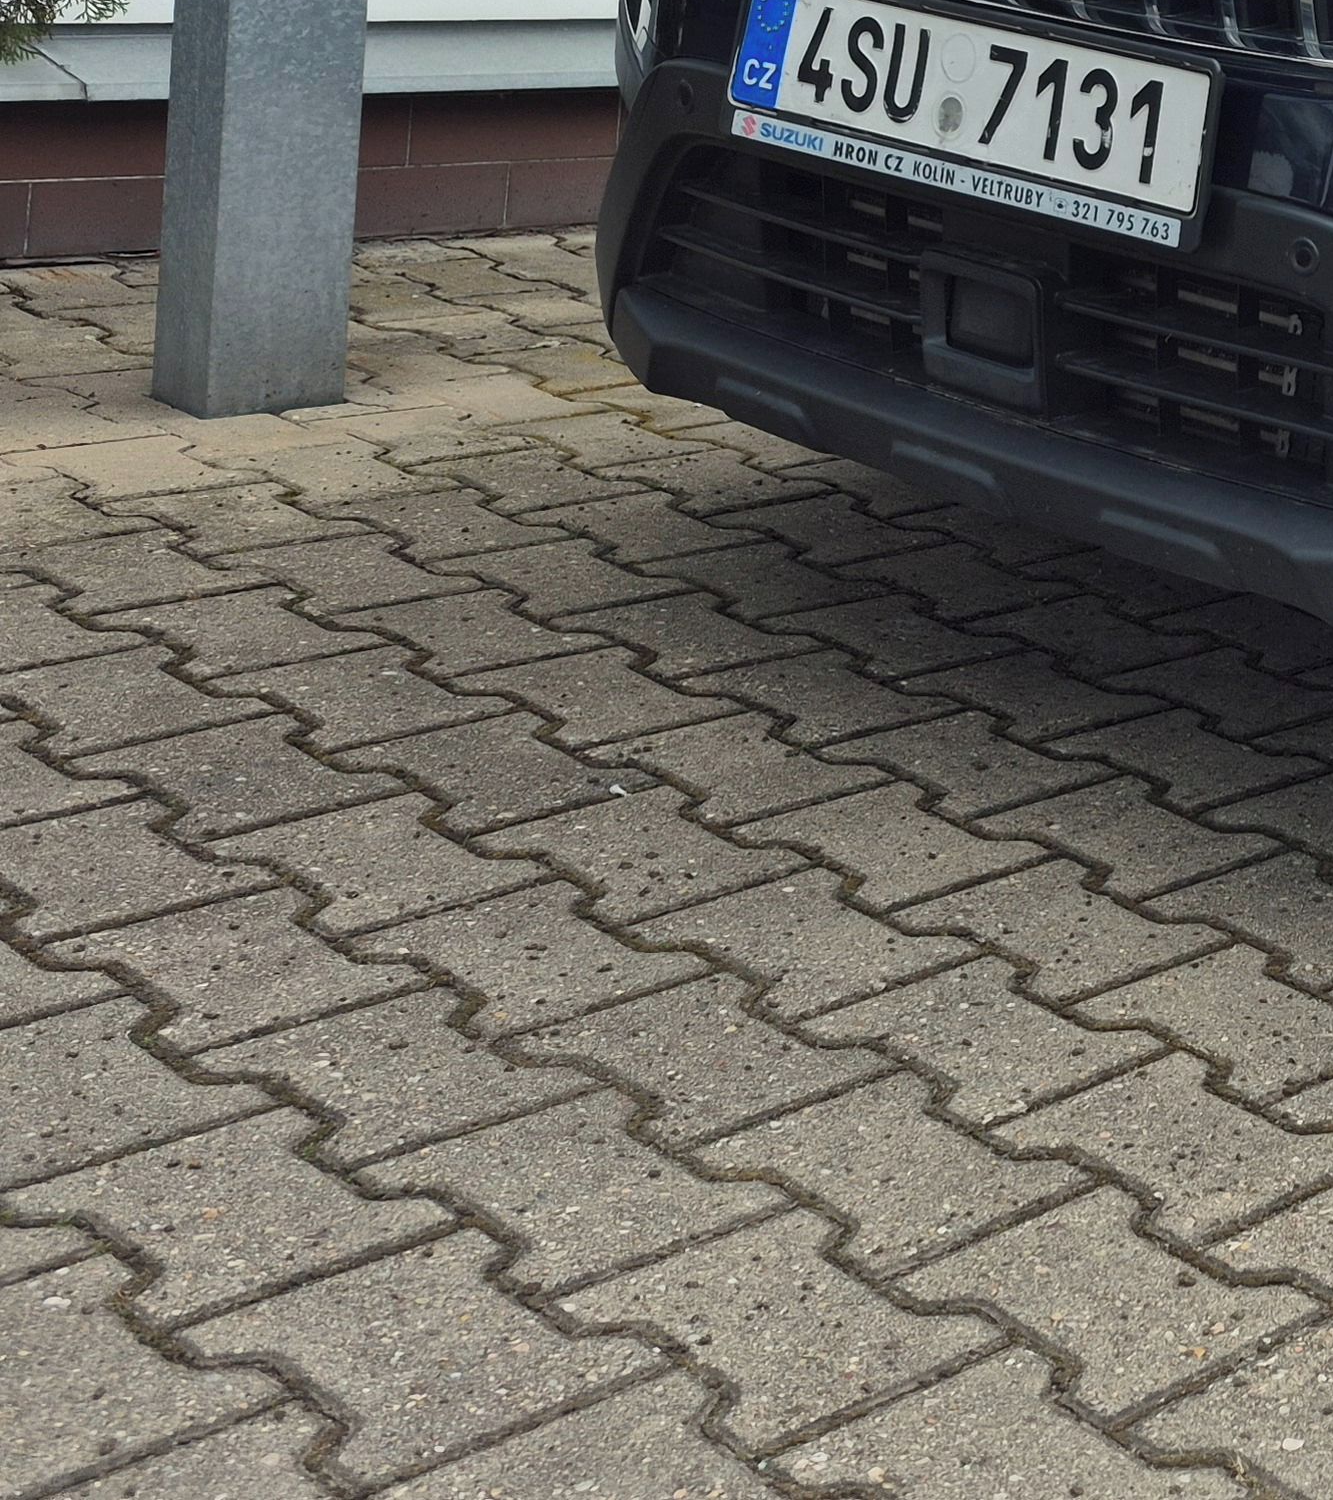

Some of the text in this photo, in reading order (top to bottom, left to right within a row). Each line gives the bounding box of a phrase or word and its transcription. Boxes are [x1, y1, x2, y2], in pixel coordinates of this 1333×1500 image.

[742, 58, 777, 90] CZ
[797, 6, 1164, 185] 4SU 7131
[759, 121, 824, 151] SUZUKI
[832, 139, 878, 167] HRON
[884, 153, 905, 173] CZ
[912, 160, 956, 187] KOLÍN
[971, 174, 1045, 208] VELTRUBY
[1071, 199, 1099, 223] 321
[1105, 208, 1135, 232] 795
